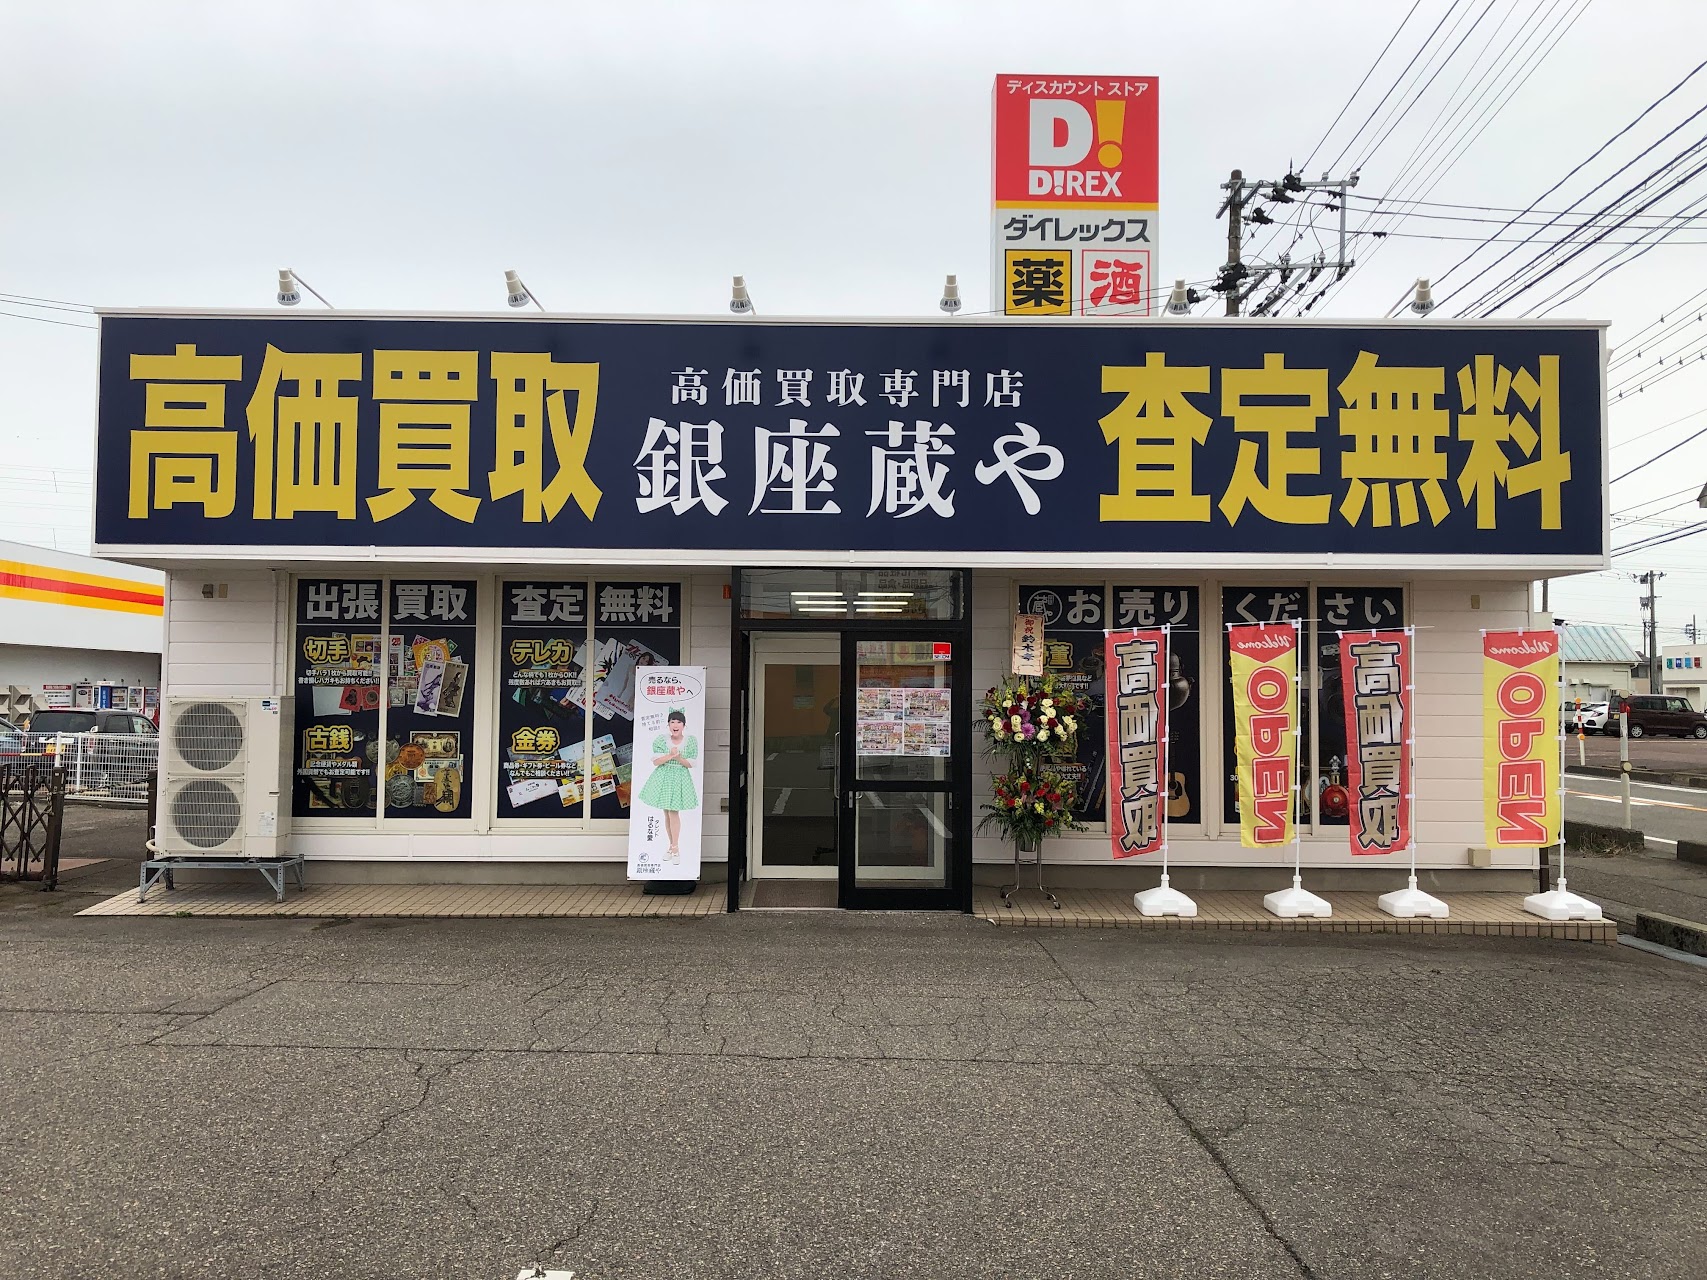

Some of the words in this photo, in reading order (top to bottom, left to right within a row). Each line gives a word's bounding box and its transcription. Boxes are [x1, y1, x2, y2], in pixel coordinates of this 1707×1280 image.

[1006, 79, 1104, 96] ディスカウント
[1107, 81, 1149, 97] ストア
[1028, 169, 1123, 197] D!REX
[1003, 214, 1151, 243] ダイレックス
[1011, 258, 1065, 308] 薬
[1089, 258, 1144, 307] 酒
[670, 366, 1025, 408] 高価買取専門店
[126, 342, 603, 524] 高価買取
[1097, 349, 1572, 530] 査定無料
[633, 416, 1065, 519] 銀座蔵や
[306, 582, 468, 621] 出張買取
[510, 584, 674, 623] 査定無料
[306, 638, 350, 663] 切手
[513, 641, 572, 664] テレカ
[308, 727, 351, 750] 古銭
[514, 729, 558, 751] 金券
